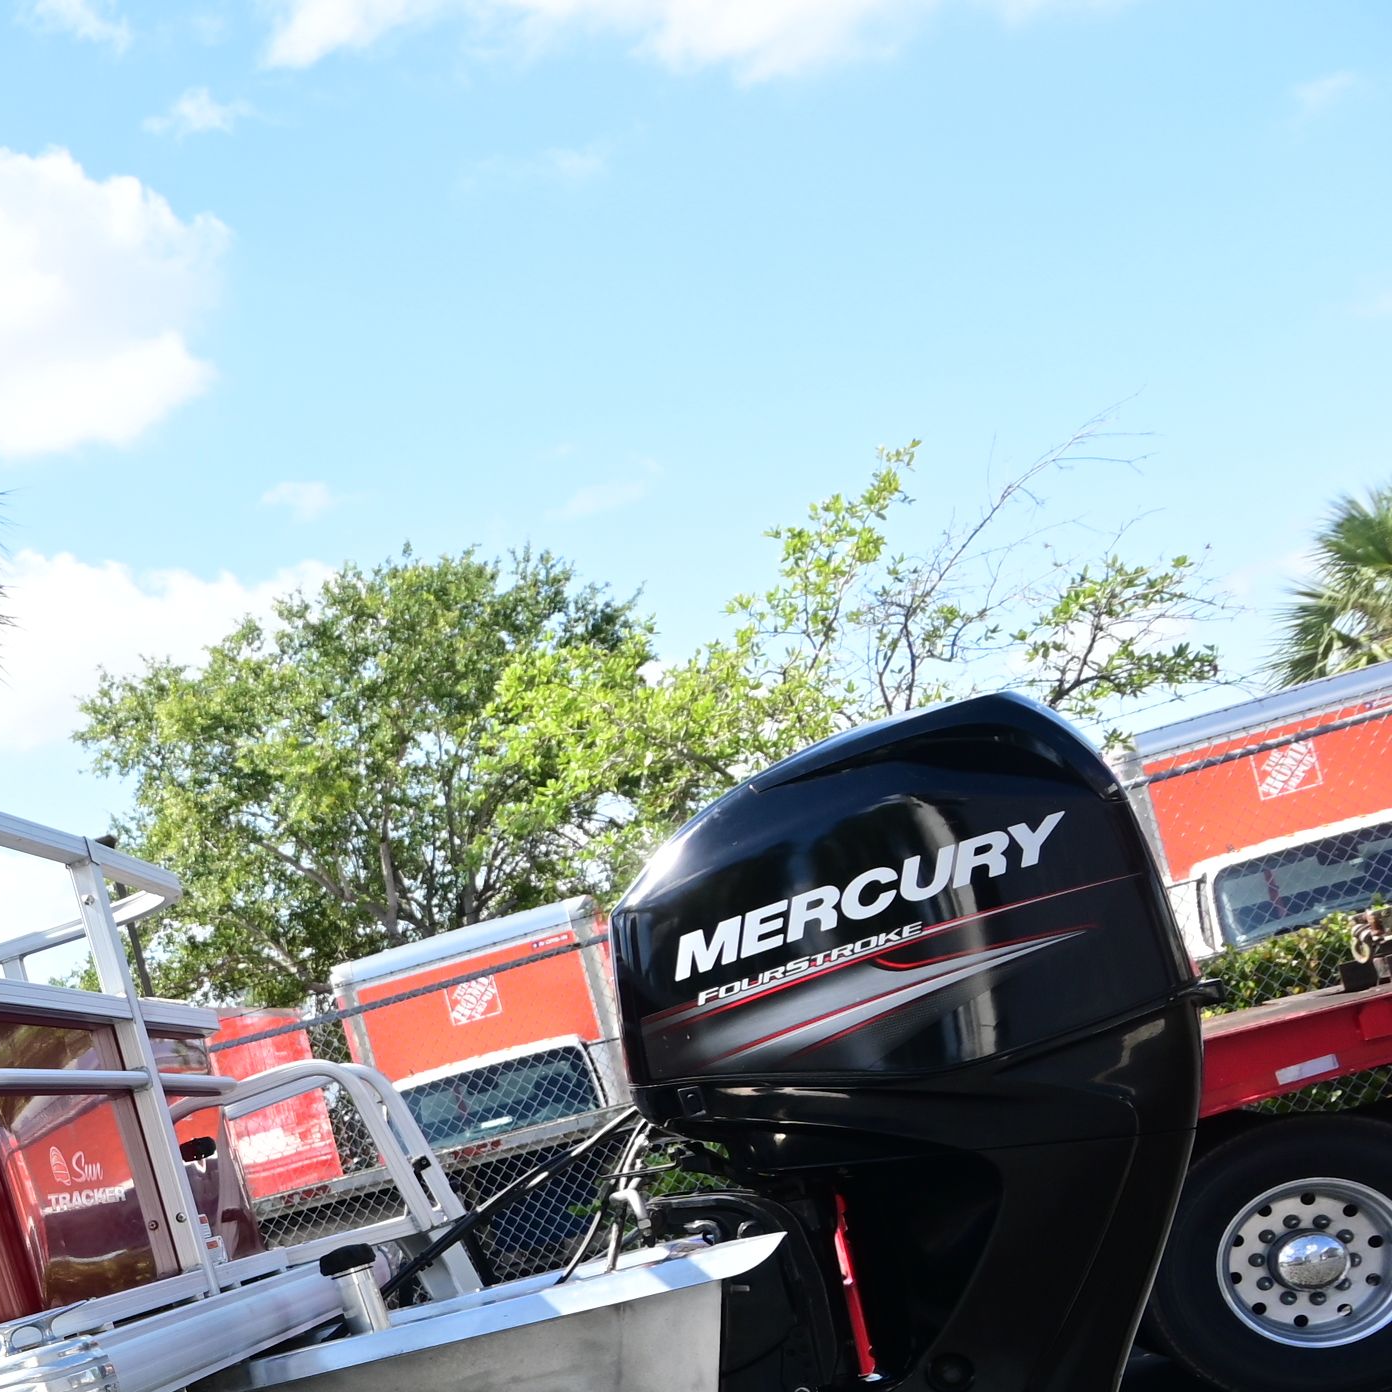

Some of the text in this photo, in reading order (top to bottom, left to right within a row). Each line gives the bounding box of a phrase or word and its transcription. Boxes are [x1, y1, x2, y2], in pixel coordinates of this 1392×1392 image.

[674, 810, 1065, 982] MERCURY
[697, 921, 923, 1007] FOURSTROKE
[71, 1150, 104, 1183] Sun
[47, 1186, 127, 1211] TRACKER
